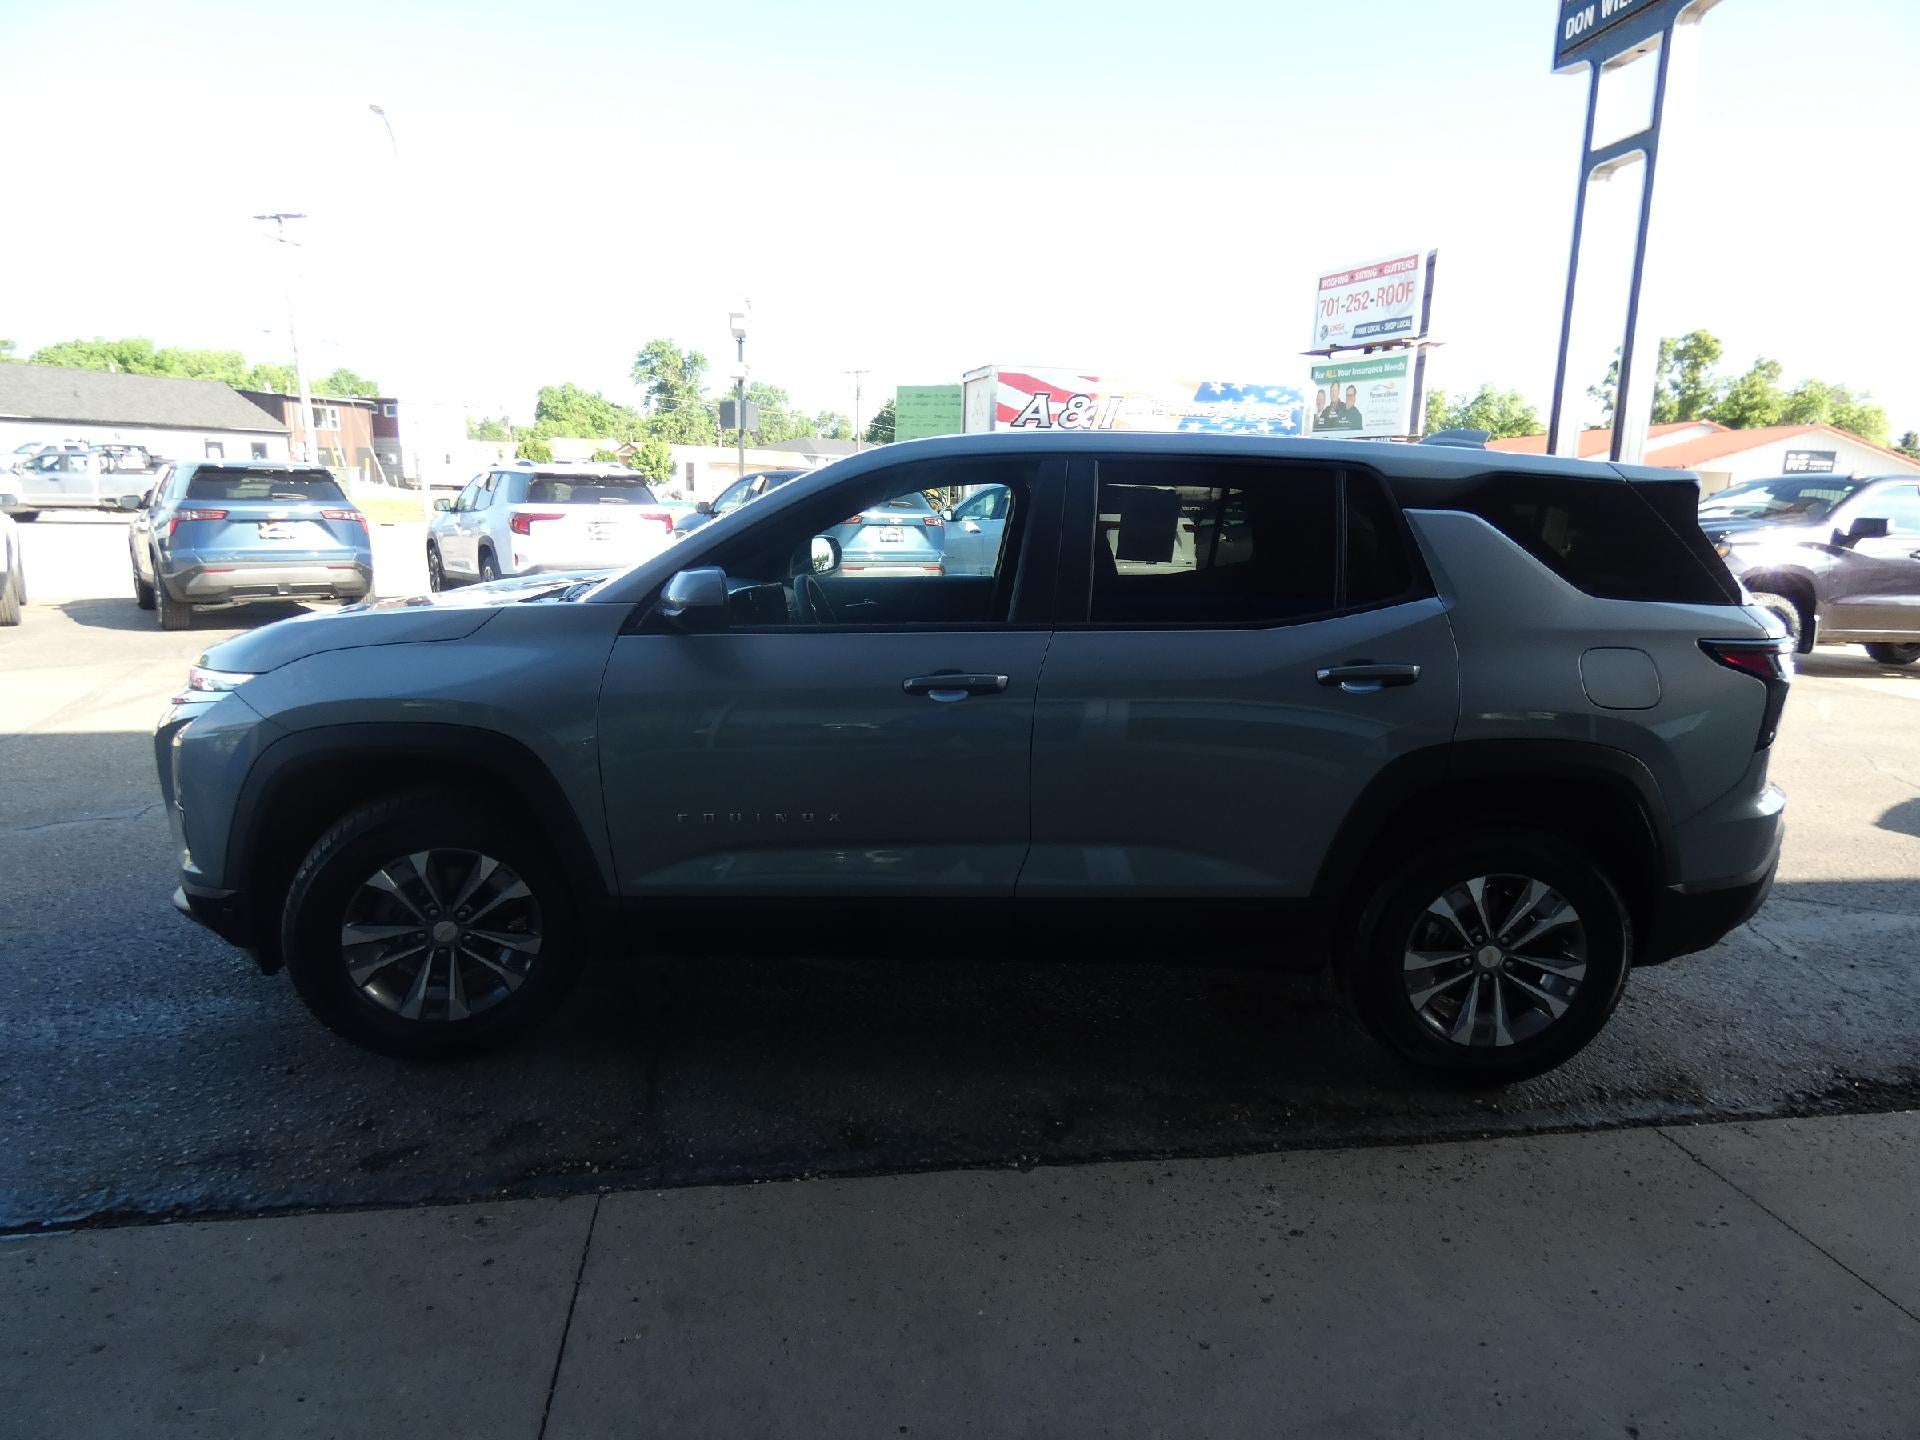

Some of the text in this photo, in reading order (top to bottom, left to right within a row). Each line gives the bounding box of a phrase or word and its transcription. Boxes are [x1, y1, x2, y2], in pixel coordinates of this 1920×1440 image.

[1566, 5, 1595, 40] DON
[1354, 268, 1377, 280] SIDING
[1384, 259, 1415, 274] GUTTERS
[1320, 281, 1414, 318] 701-252-ROOF
[1337, 368, 1352, 378] Your
[1352, 366, 1382, 376] Insurance
[1384, 362, 1405, 372] Needs
[677, 812, 841, 824] EQUINOX
